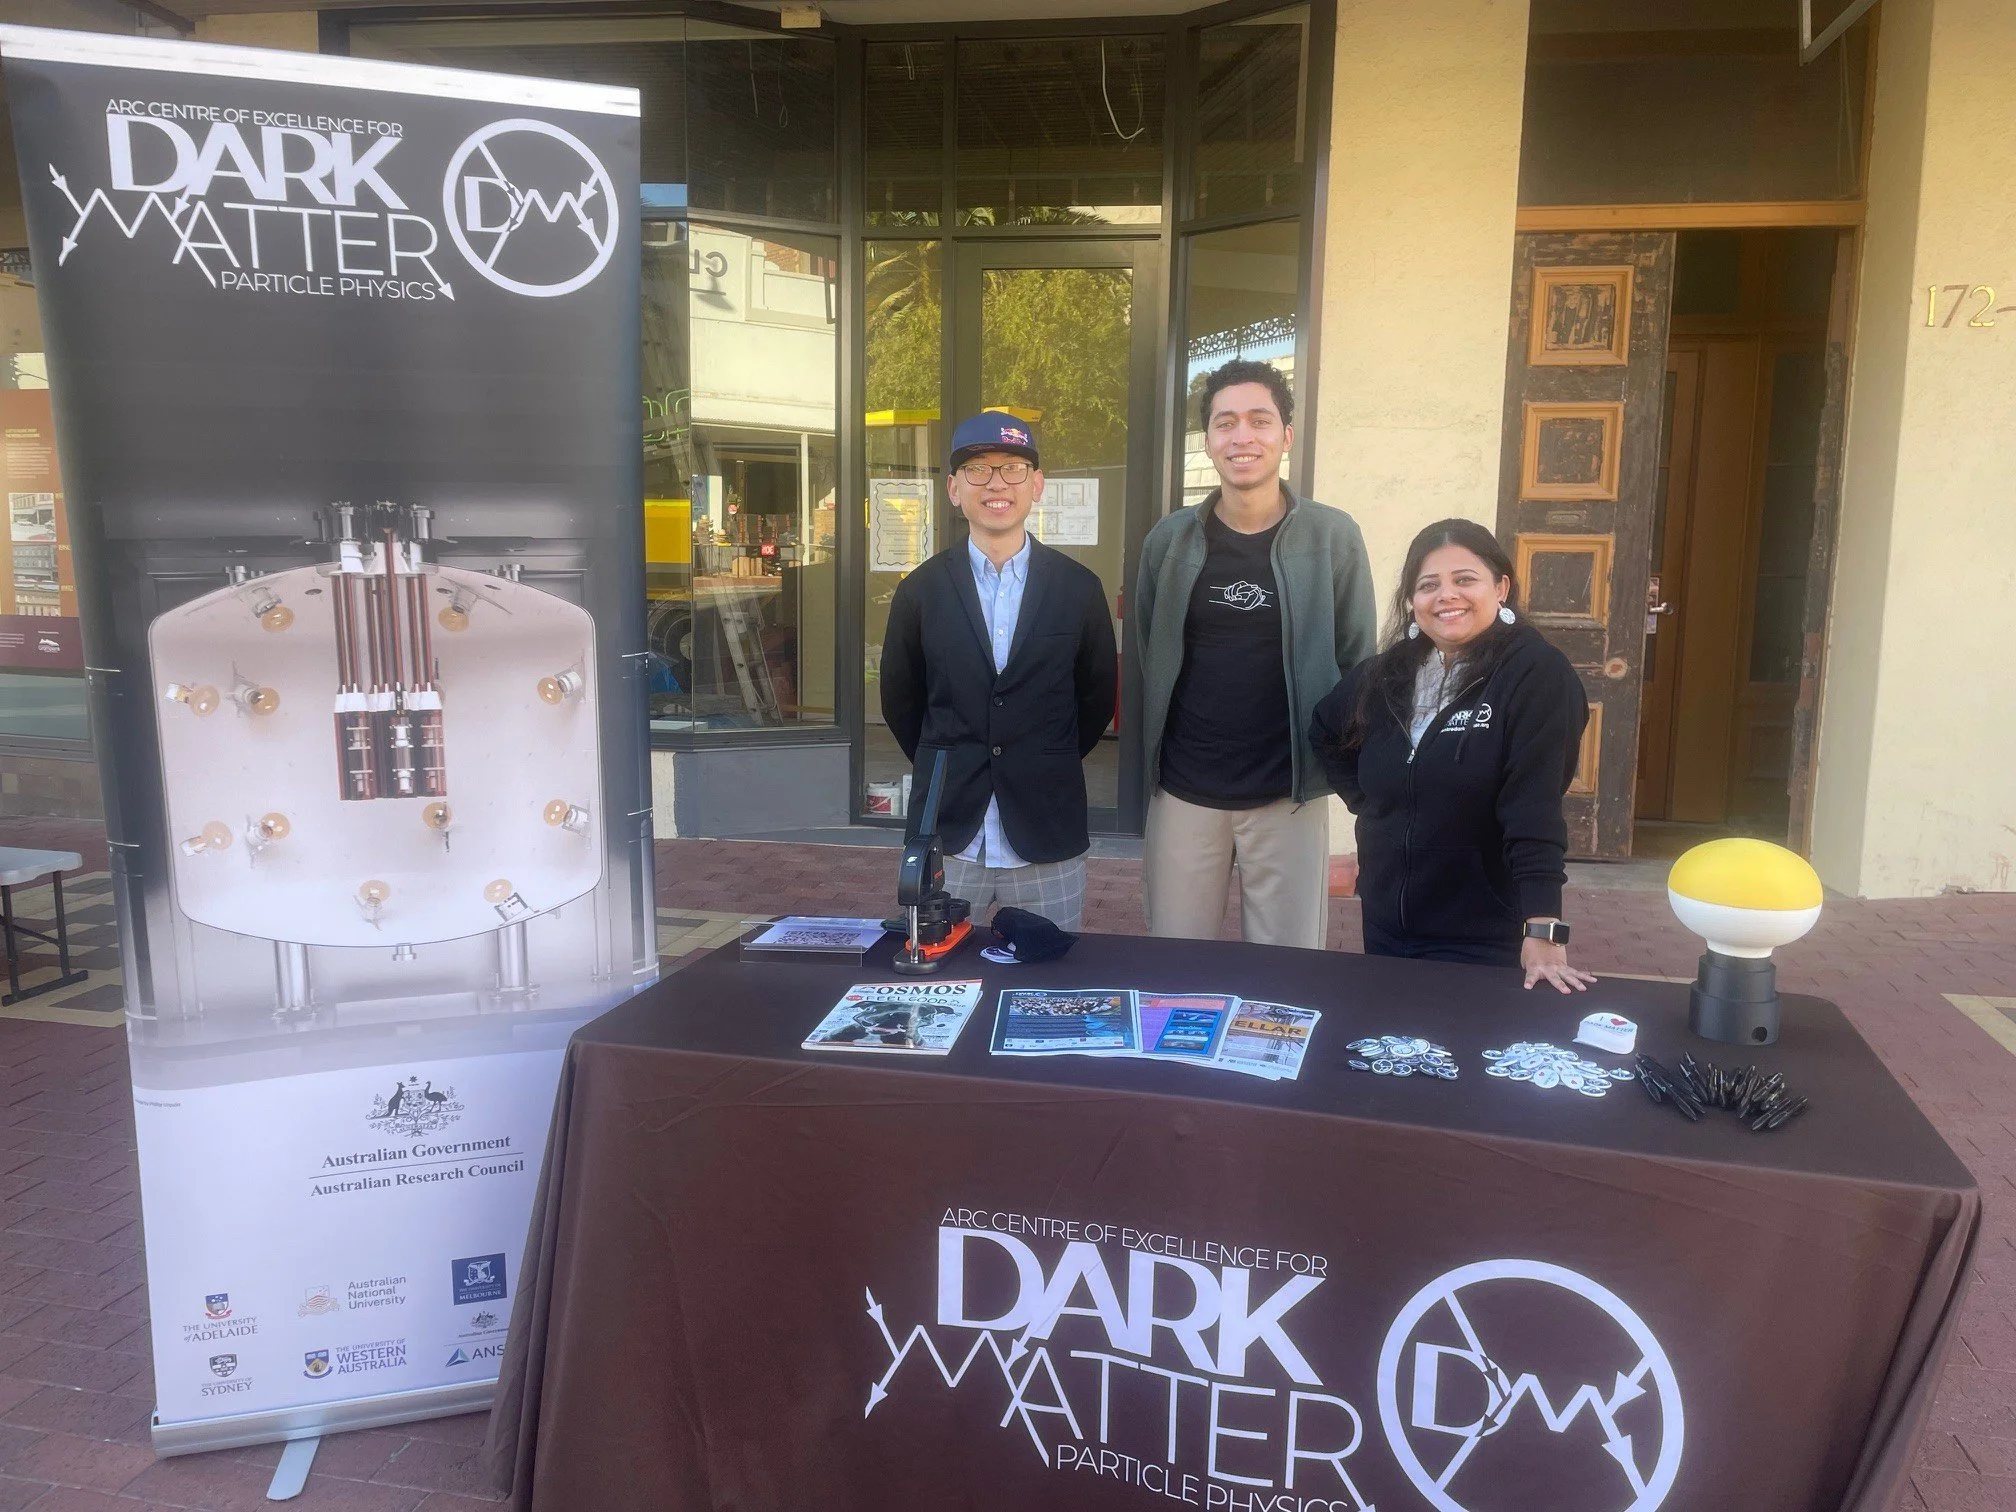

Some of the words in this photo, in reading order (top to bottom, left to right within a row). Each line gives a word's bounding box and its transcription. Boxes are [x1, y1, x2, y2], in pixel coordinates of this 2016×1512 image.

[106, 98, 145, 115] ARC
[148, 101, 222, 122] CENTRE
[224, 107, 249, 124] OF
[253, 111, 365, 135] EXCELLENCE
[367, 120, 403, 137] FOR
[106, 112, 410, 210] DARK
[58, 186, 455, 300] MATTER
[221, 270, 335, 296] PARTICLE
[341, 277, 436, 300] PHYSICS
[1450, 709, 1474, 721] ARK
[322, 1148, 408, 1169] Australian
[411, 1135, 512, 1158] Government
[311, 1177, 391, 1197] Australian
[395, 1168, 464, 1186] Research
[468, 1160, 524, 1177] Council
[940, 1207, 989, 1230] ARC
[991, 1212, 1081, 1241] CENTRE
[1083, 1222, 1119, 1243] OF
[1121, 1227, 1271, 1269] EXCELLENCE
[1275, 1250, 1328, 1277] FOR
[347, 1276, 407, 1290] Australian
[347, 1286, 397, 1300] National
[348, 1296, 407, 1310] University
[937, 1226, 1325, 1386] DARK
[183, 1324, 200, 1332] THE
[203, 1316, 258, 1330] UNIVERSITY
[192, 1324, 259, 1342] ADELAIDE
[336, 1344, 407, 1364] WESTERN
[352, 1339, 396, 1351] UNIVERSITY
[338, 1356, 407, 1375] AUSTRALIA
[201, 1381, 253, 1397] SYDNEY
[865, 1324, 1376, 1512] MATTER
[1056, 1444, 1200, 1506] PARTICLE
